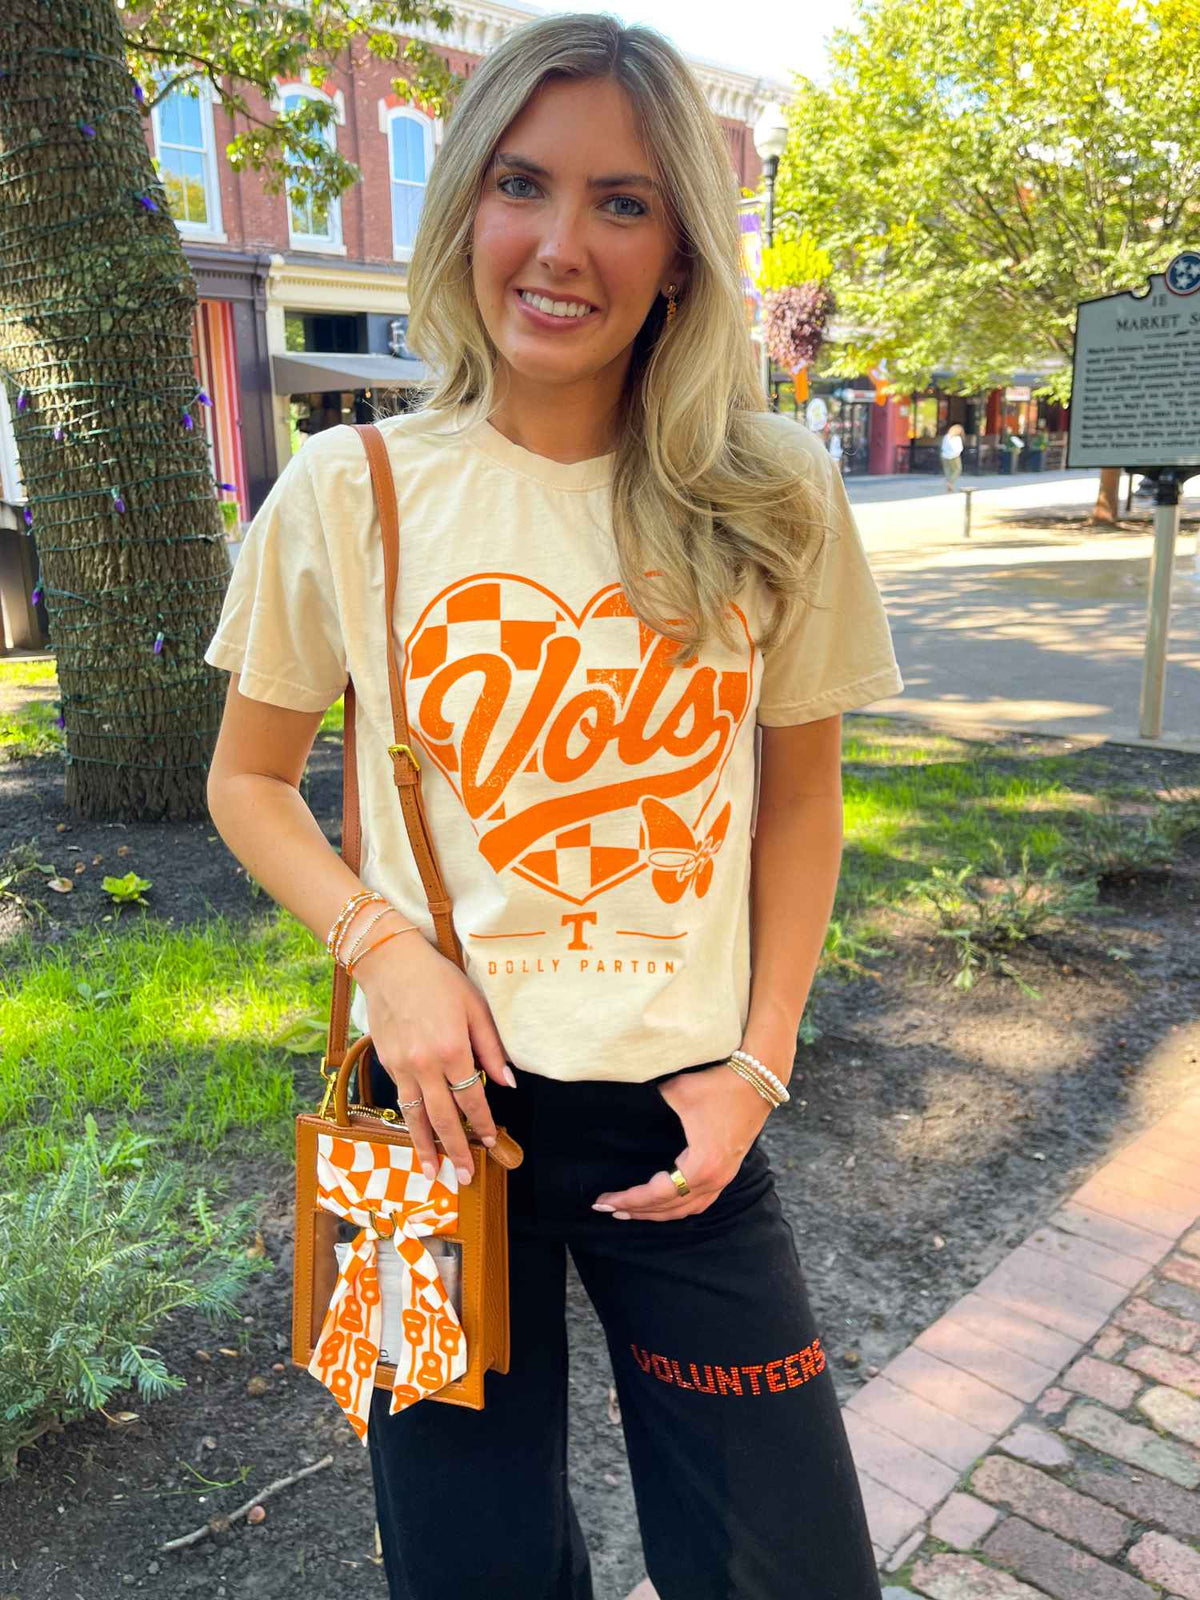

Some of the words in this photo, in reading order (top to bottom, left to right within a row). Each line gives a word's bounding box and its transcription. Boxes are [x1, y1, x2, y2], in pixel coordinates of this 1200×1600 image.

[1116, 314, 1181, 333] MARKET
[1188, 311, 1200, 327] S
[418, 634, 732, 822] Vols
[561, 912, 597, 950] T
[488, 959, 560, 975] DOLLY
[580, 959, 675, 974] PARTON
[630, 1337, 827, 1396] VOLUNTEERS
